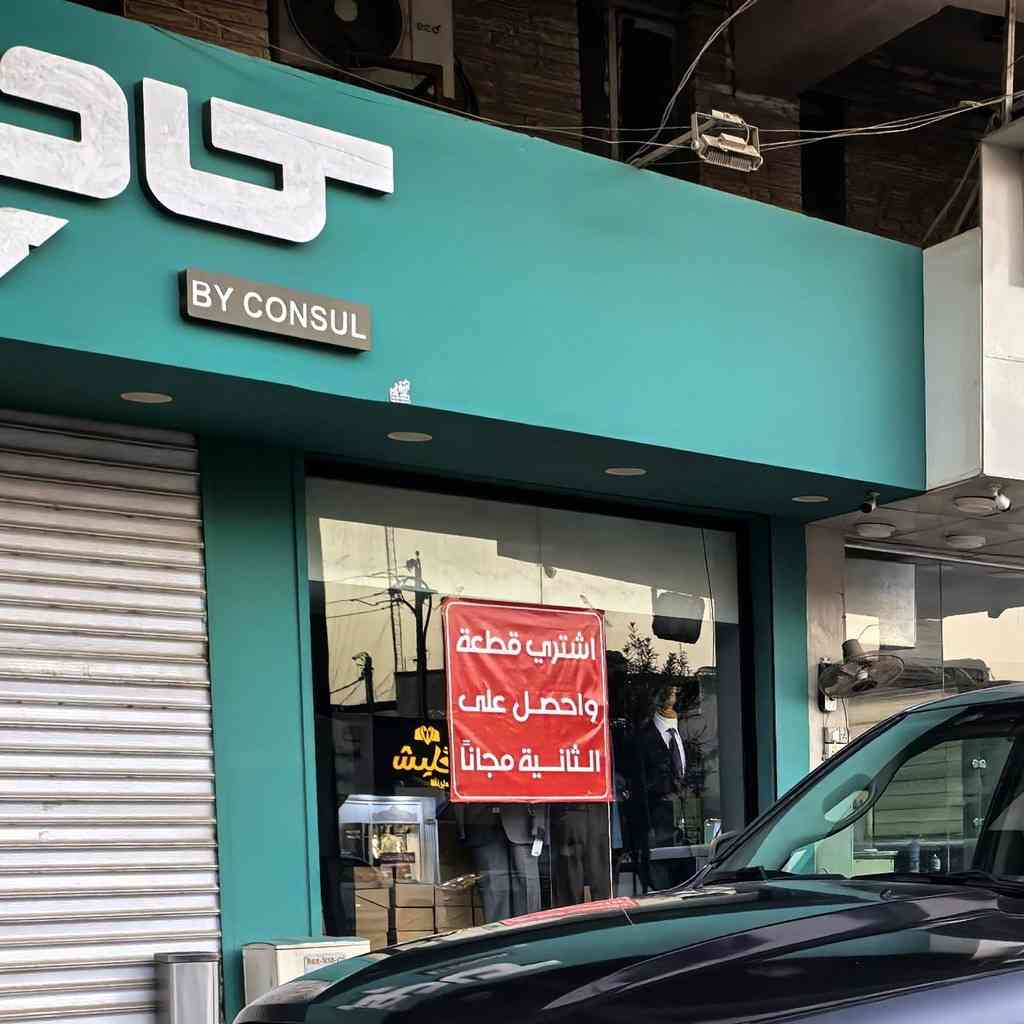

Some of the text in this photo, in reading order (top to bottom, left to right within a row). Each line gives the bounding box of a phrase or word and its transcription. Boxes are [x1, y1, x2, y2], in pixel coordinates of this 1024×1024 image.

[192, 279, 367, 340] BY CONSUL
[456, 627, 596, 665] اشتري قطعة
[458, 688, 599, 724] واحصل على
[518, 744, 600, 779] الثانية
